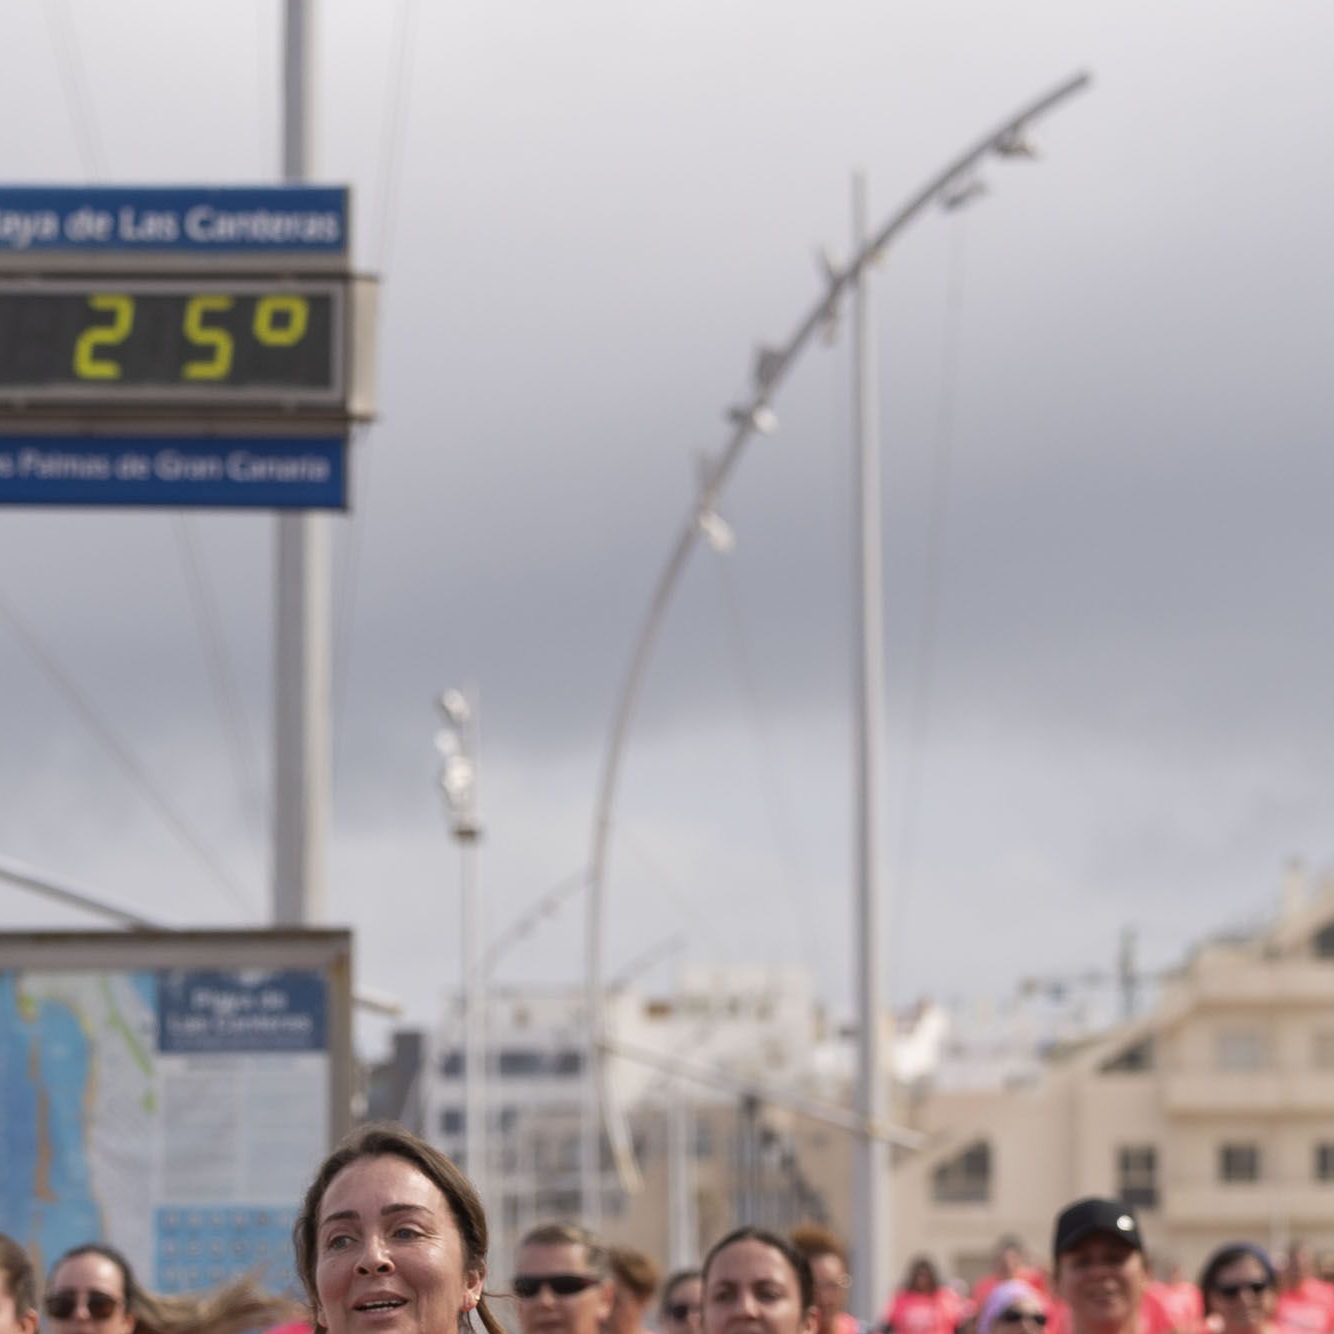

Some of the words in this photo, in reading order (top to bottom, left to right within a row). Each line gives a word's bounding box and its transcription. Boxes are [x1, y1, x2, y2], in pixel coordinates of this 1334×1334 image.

[64, 205, 114, 242] de
[119, 206, 177, 242] Las
[185, 206, 340, 242] Canteras
[17, 448, 111, 480] Palmas
[115, 450, 150, 480] de
[154, 449, 223, 482] Gran
[226, 450, 331, 482] Canaria
